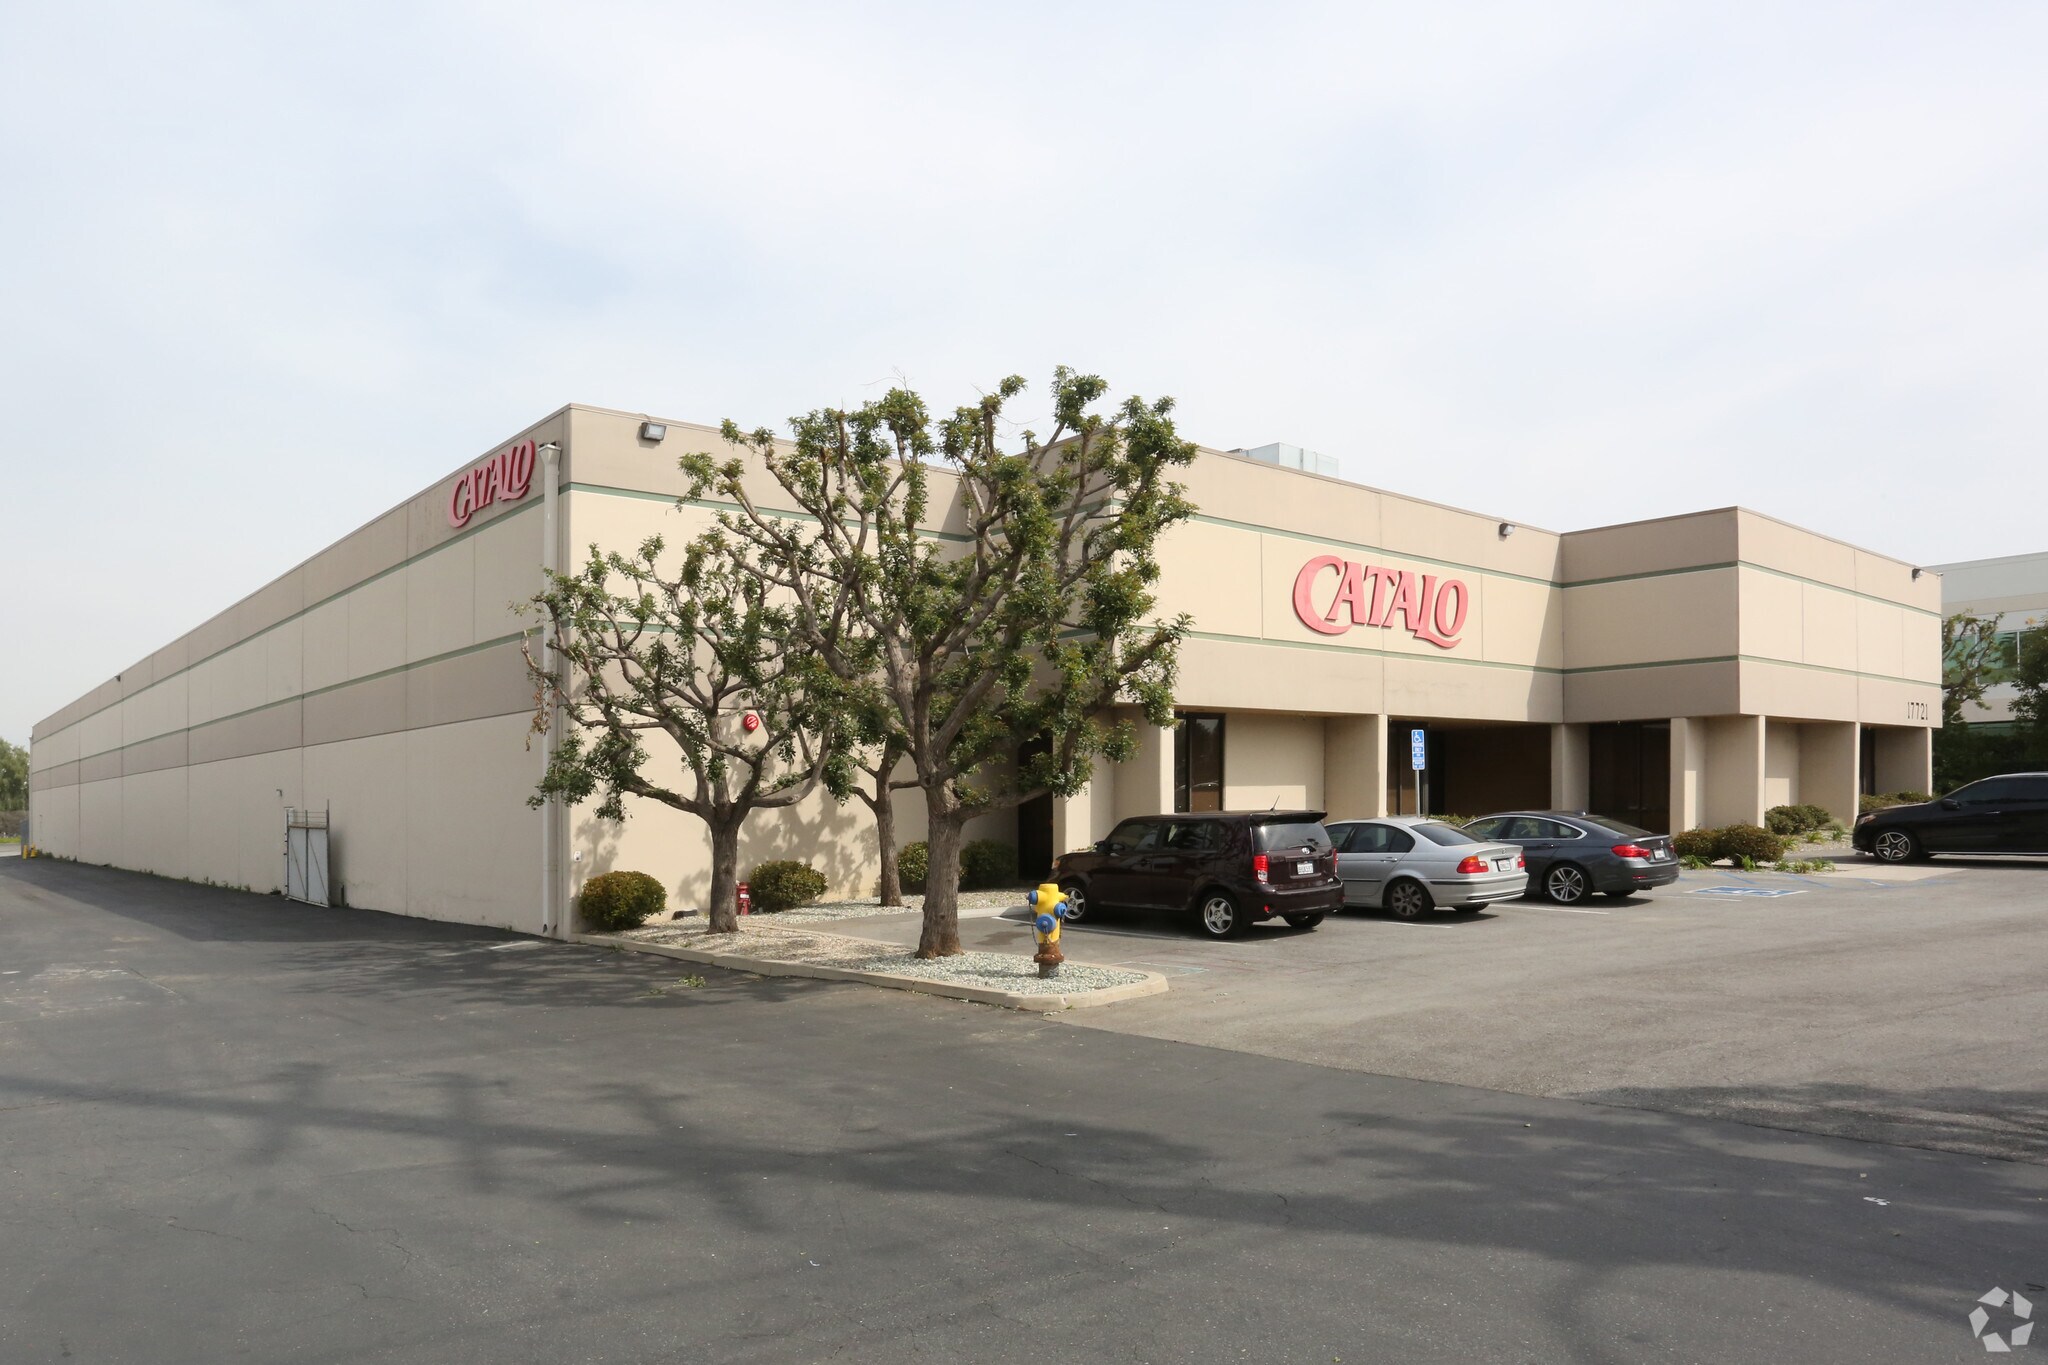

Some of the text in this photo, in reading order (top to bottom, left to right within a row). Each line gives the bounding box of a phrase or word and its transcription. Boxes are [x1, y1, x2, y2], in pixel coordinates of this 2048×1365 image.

[448, 439, 536, 528] CATALO
[1292, 554, 1469, 649] CATALO
[1907, 701, 1928, 720] 17721
